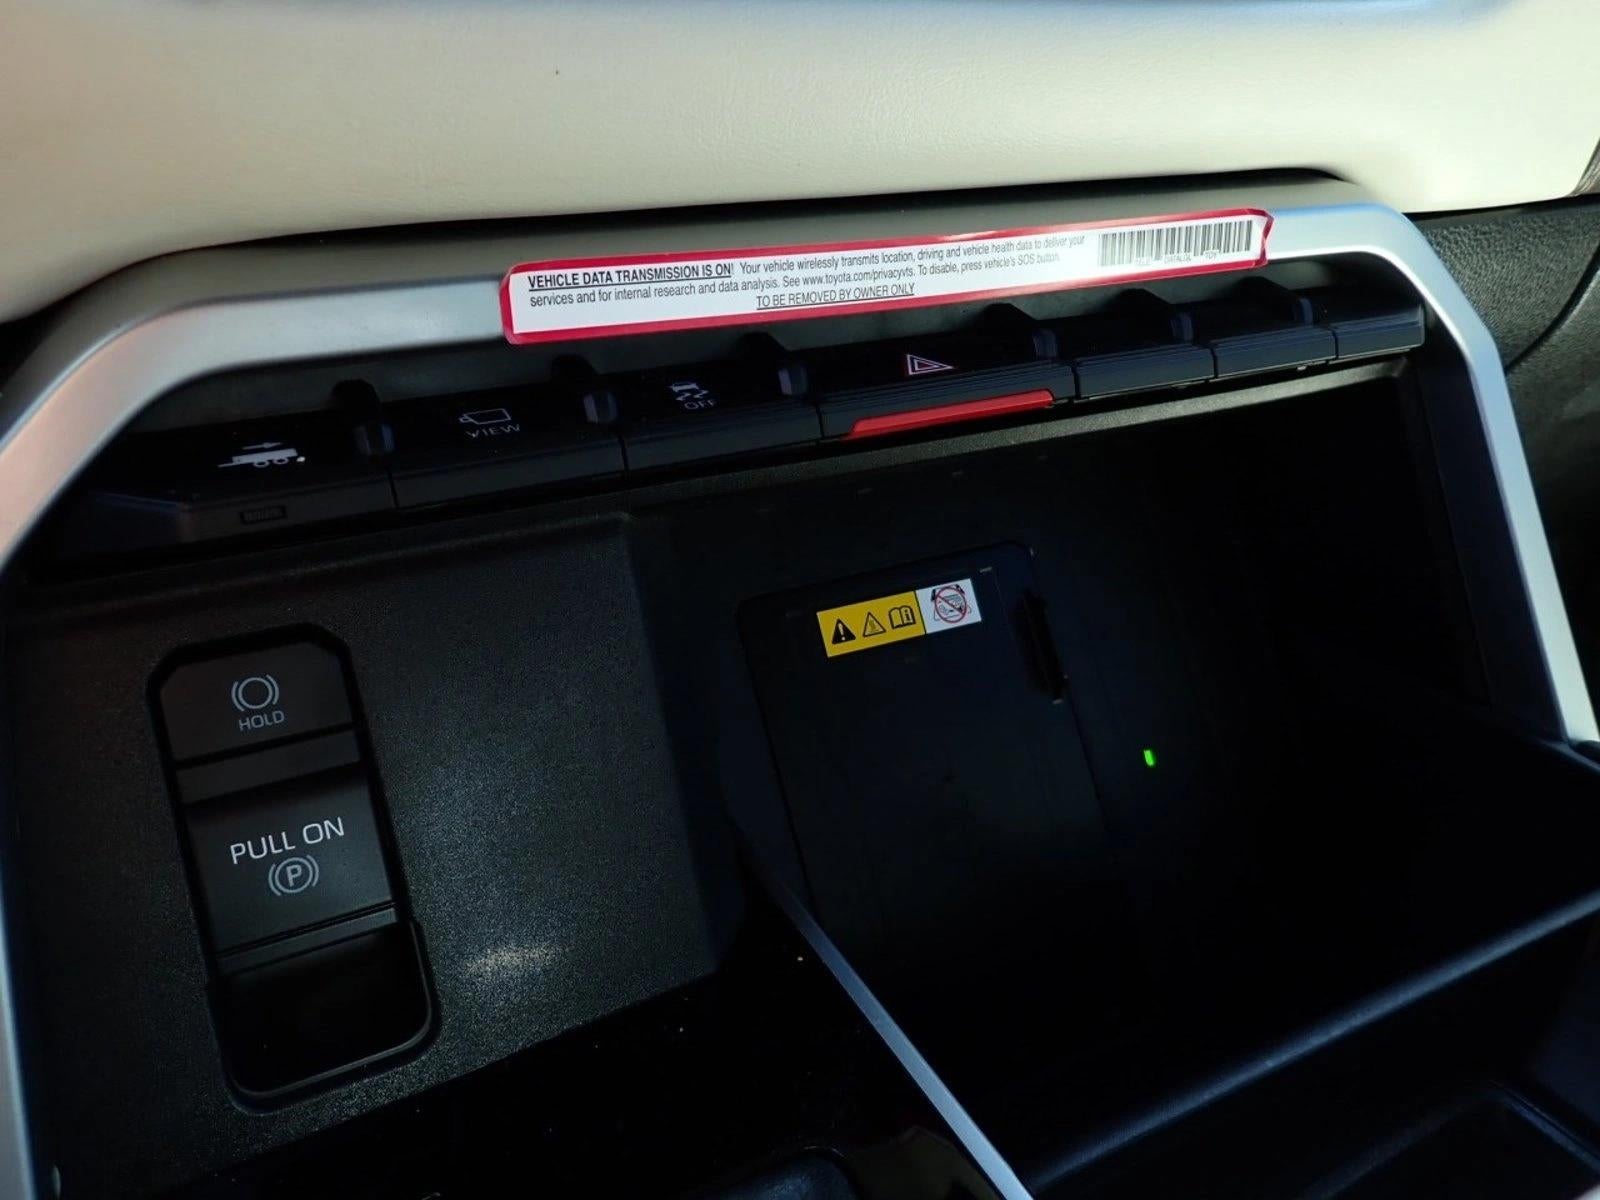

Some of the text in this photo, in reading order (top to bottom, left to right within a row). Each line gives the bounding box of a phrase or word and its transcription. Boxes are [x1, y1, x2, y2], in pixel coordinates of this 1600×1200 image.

[528, 235, 1085, 288] VEHICLE DATA TRANSMISSION IS ON! Your vehicle wirelessly transmits location, driving and vehicle health data to deliver your
[530, 293, 574, 307] services
[577, 290, 596, 303] and
[599, 289, 611, 302] for
[615, 286, 651, 300] internal
[654, 283, 695, 298] research
[698, 281, 716, 294] and
[719, 279, 739, 292] data
[741, 276, 780, 292] analysis.
[782, 275, 801, 288] See
[803, 266, 916, 285] www.toyota.com/privacyvts.
[918, 264, 927, 276] To
[929, 261, 959, 275] disable,
[961, 259, 982, 274] press
[984, 255, 1016, 269] vehicle's
[1017, 253, 1035, 266] SOS
[757, 282, 915, 307] TO BE REMOVED BY OWNER ONLY
[683, 398, 718, 411] OFF
[465, 422, 521, 438] VIEW
[239, 710, 285, 731] HOLD
[229, 816, 345, 865] PULL ON
[285, 864, 302, 888] P
